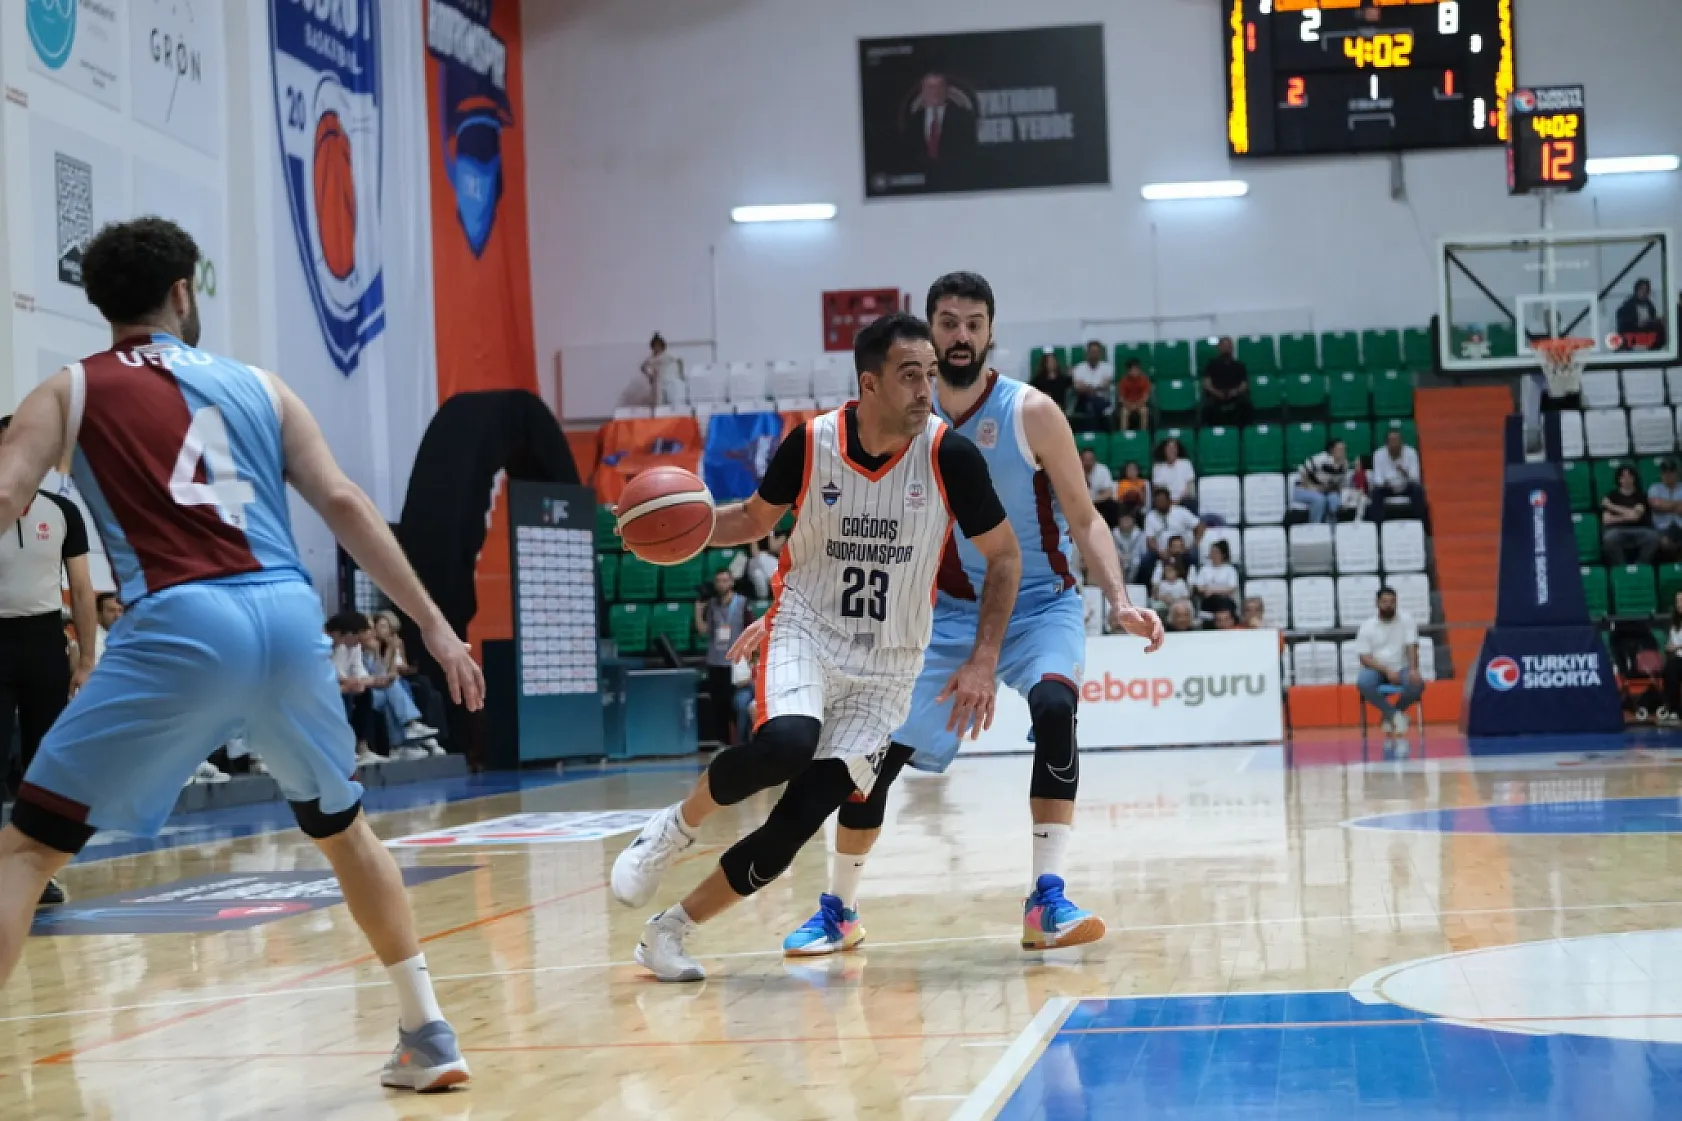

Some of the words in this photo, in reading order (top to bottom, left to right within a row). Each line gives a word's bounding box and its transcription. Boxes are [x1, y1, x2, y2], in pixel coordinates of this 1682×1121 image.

[1301, 8, 1321, 41] 2
[1438, 1, 1458, 34] 8
[1343, 34, 1414, 68] 4:02
[1287, 76, 1305, 106] 2
[1533, 114, 1579, 138] 4:02
[1541, 142, 1575, 181] 12
[168, 405, 256, 531] 4
[826, 539, 914, 565] BODRUMSPOR
[840, 566, 889, 622] 23
[1077, 671, 1266, 706] ebap.guru
